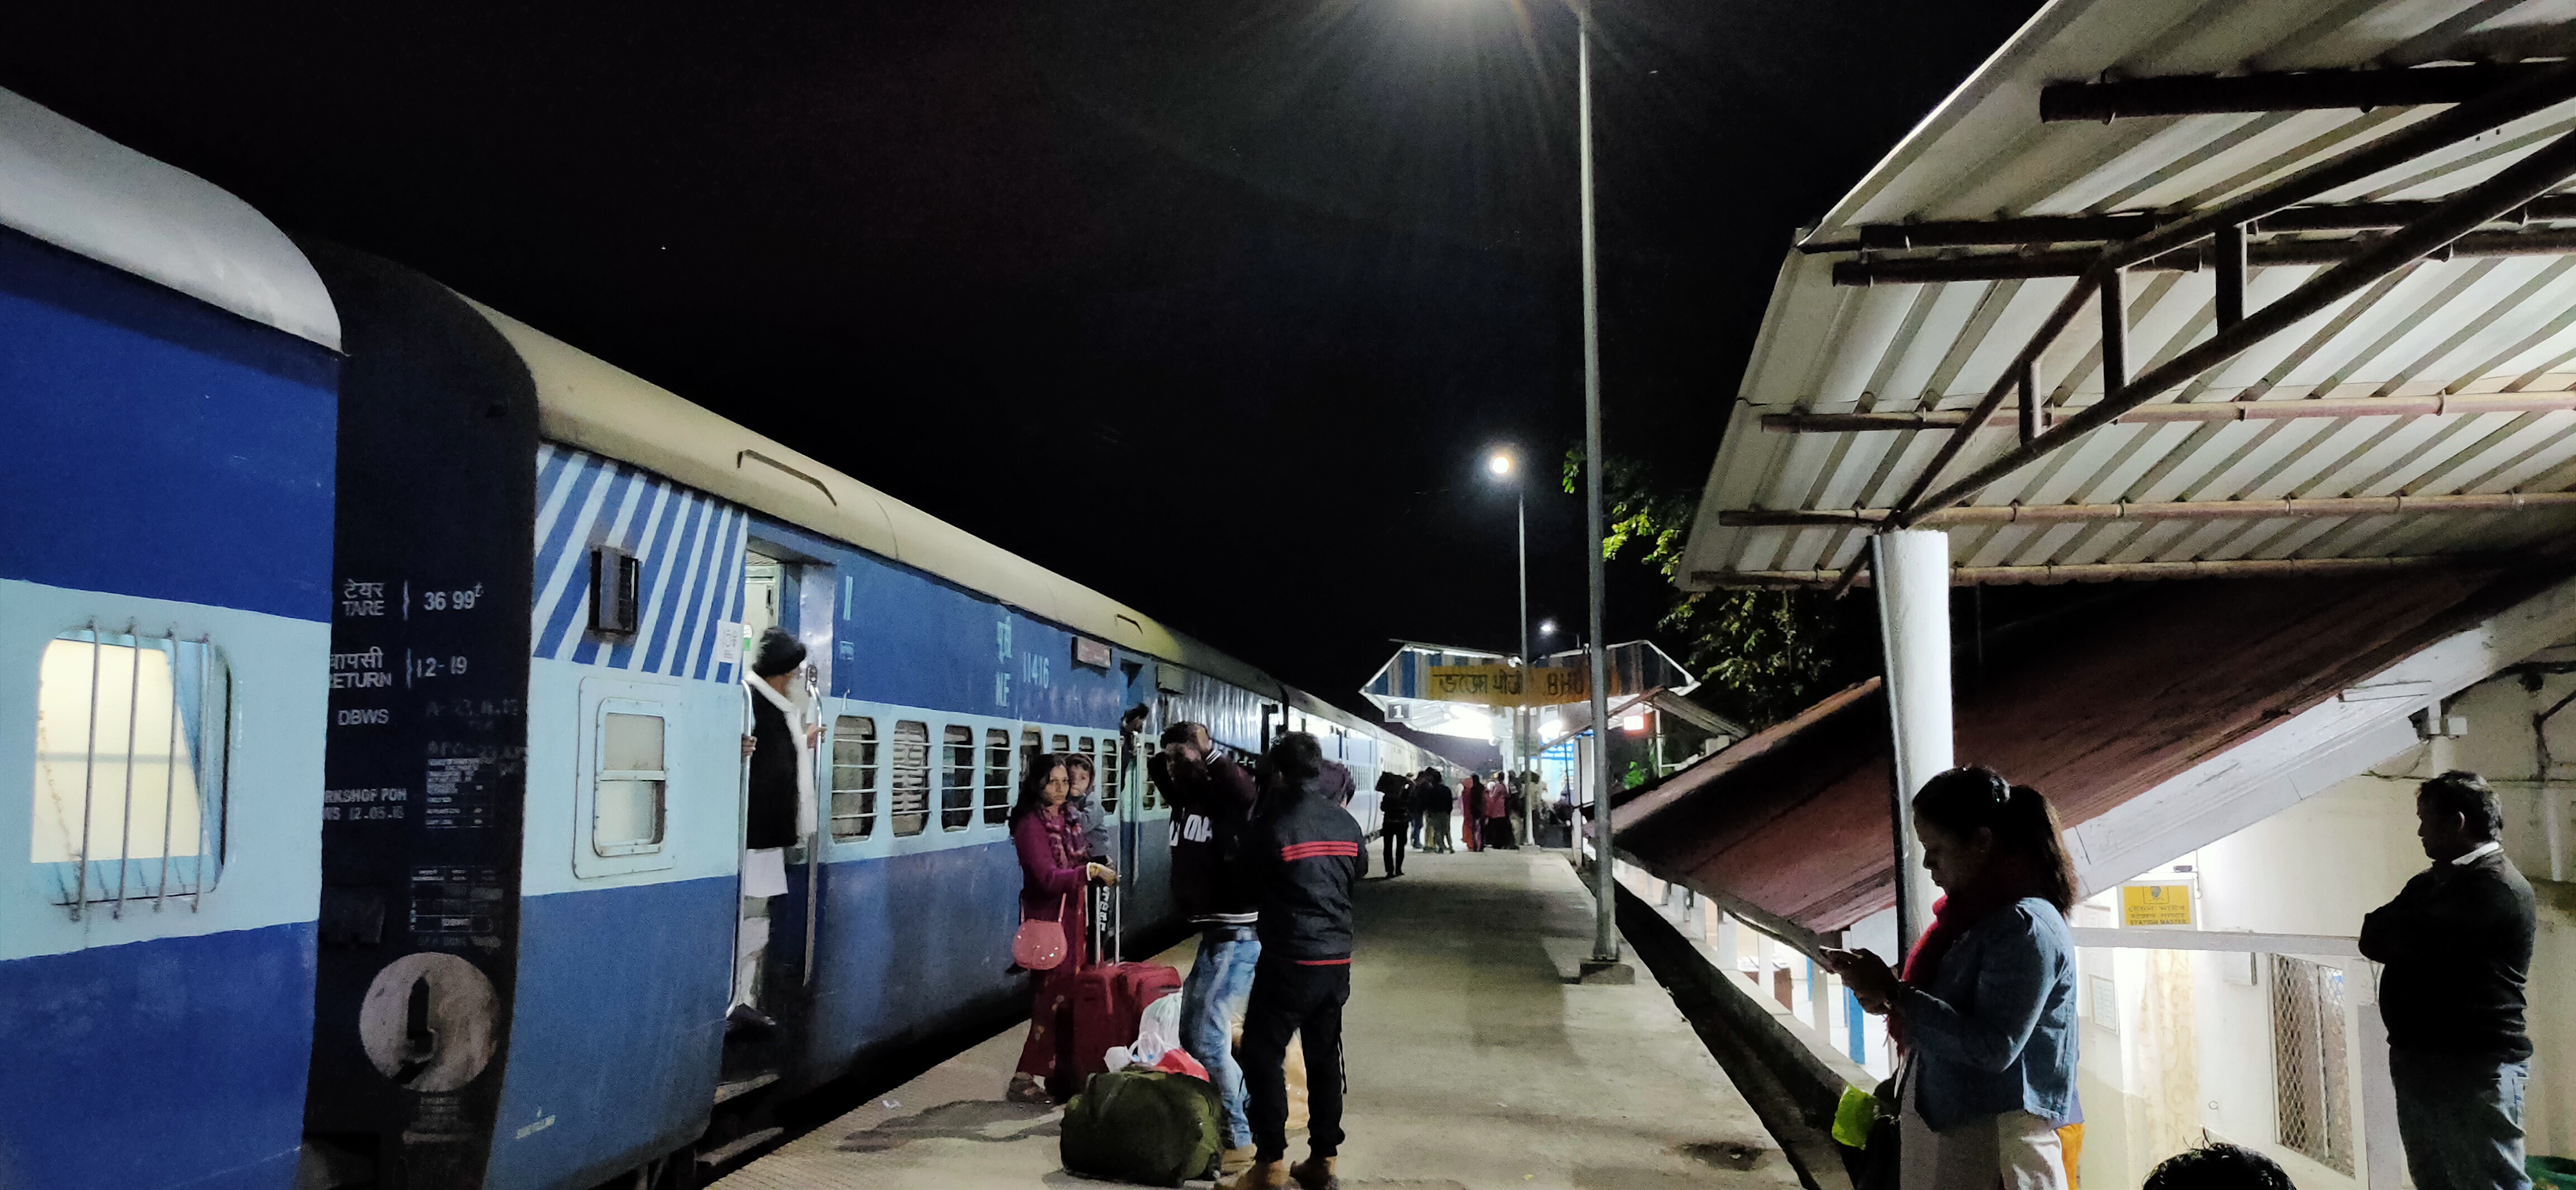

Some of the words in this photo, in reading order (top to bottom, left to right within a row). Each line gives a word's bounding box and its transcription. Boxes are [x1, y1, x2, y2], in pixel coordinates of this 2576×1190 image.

[342, 600, 385, 616] TARE
[1023, 651, 1049, 689] 11416
[338, 709, 390, 726] DBWS
[1394, 705, 1404, 718] 1
